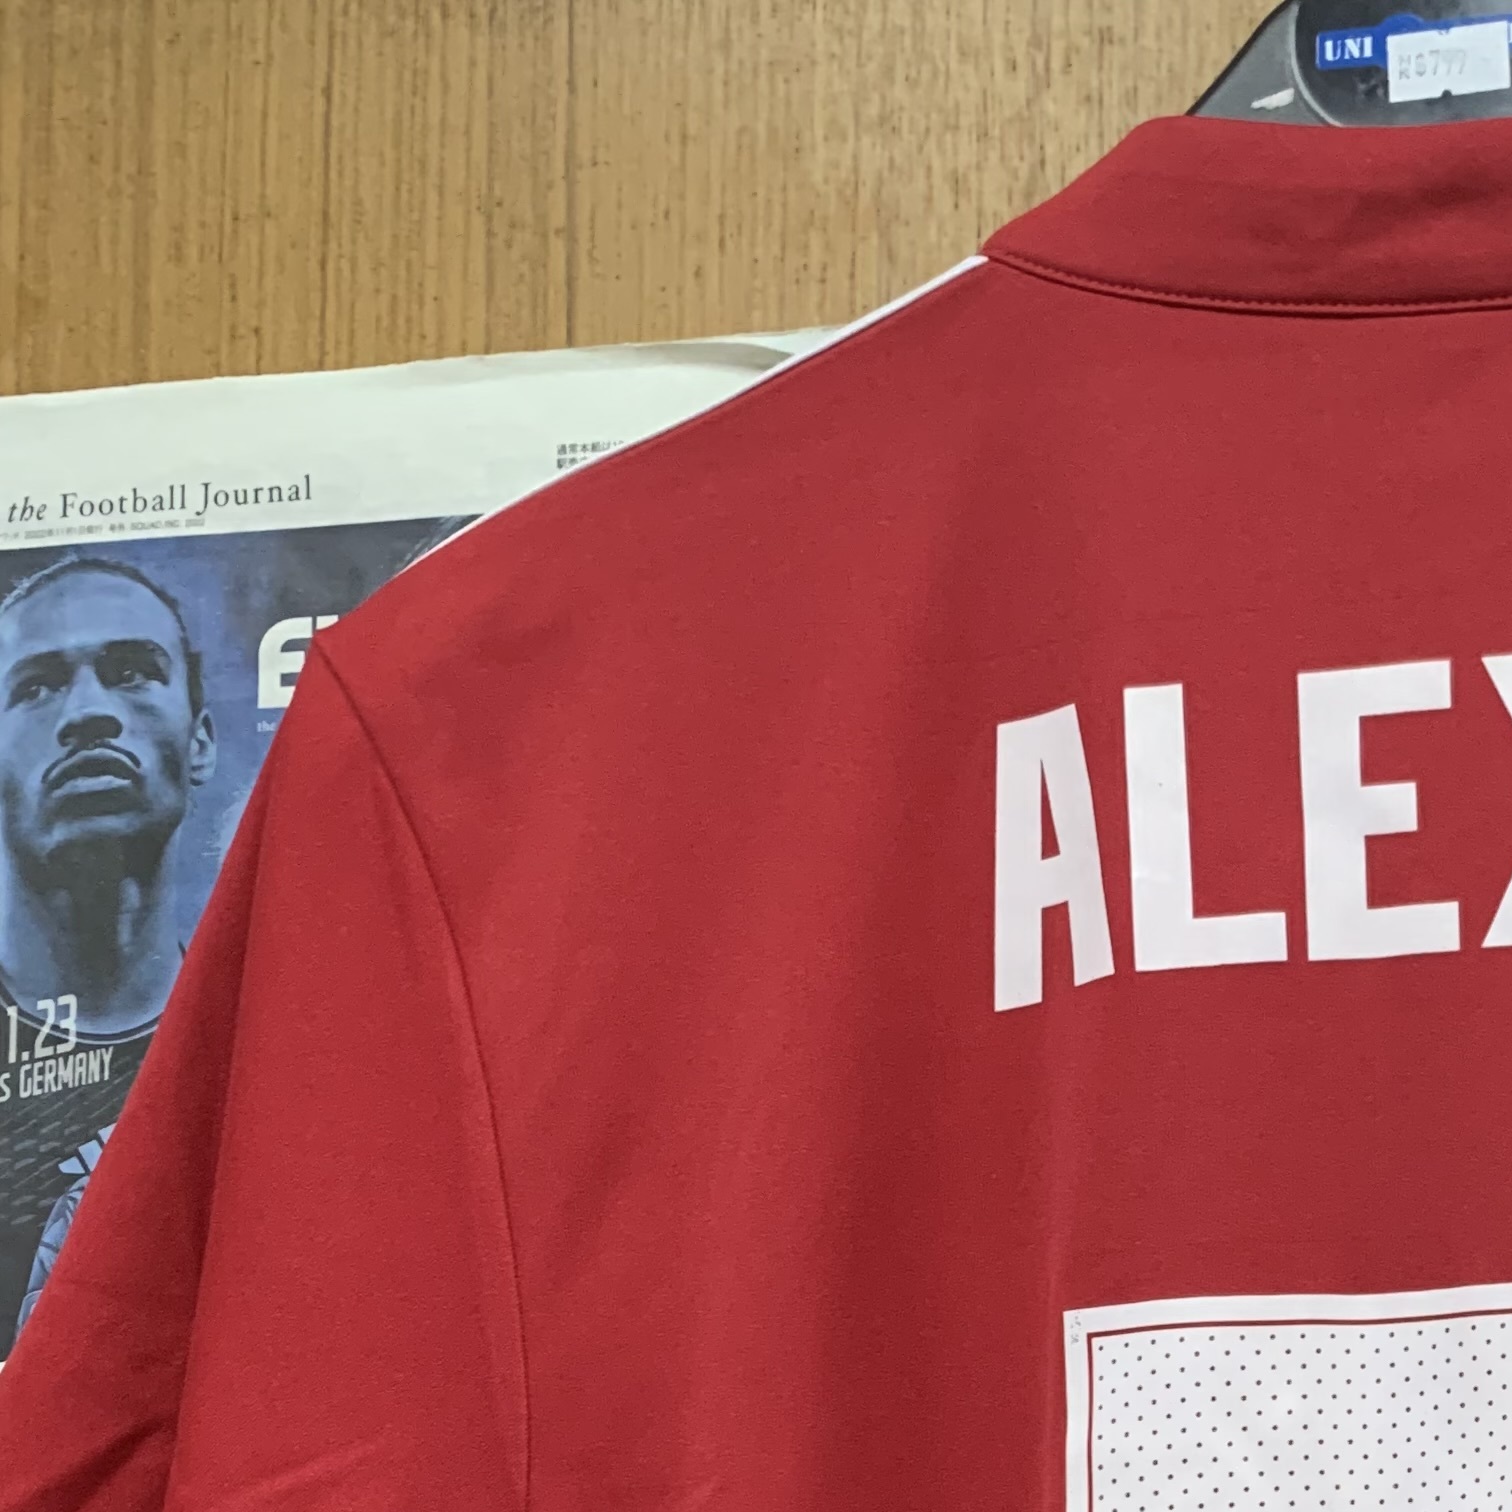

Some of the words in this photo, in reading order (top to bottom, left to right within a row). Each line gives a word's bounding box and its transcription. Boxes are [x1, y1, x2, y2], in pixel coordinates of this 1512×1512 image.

[1324, 36, 1374, 62] UNI
[8, 496, 47, 523] the
[59, 483, 187, 519] Football
[195, 475, 313, 517] Journal
[7, 994, 77, 1064] 1.23
[20, 1046, 114, 1099] GERMANY
